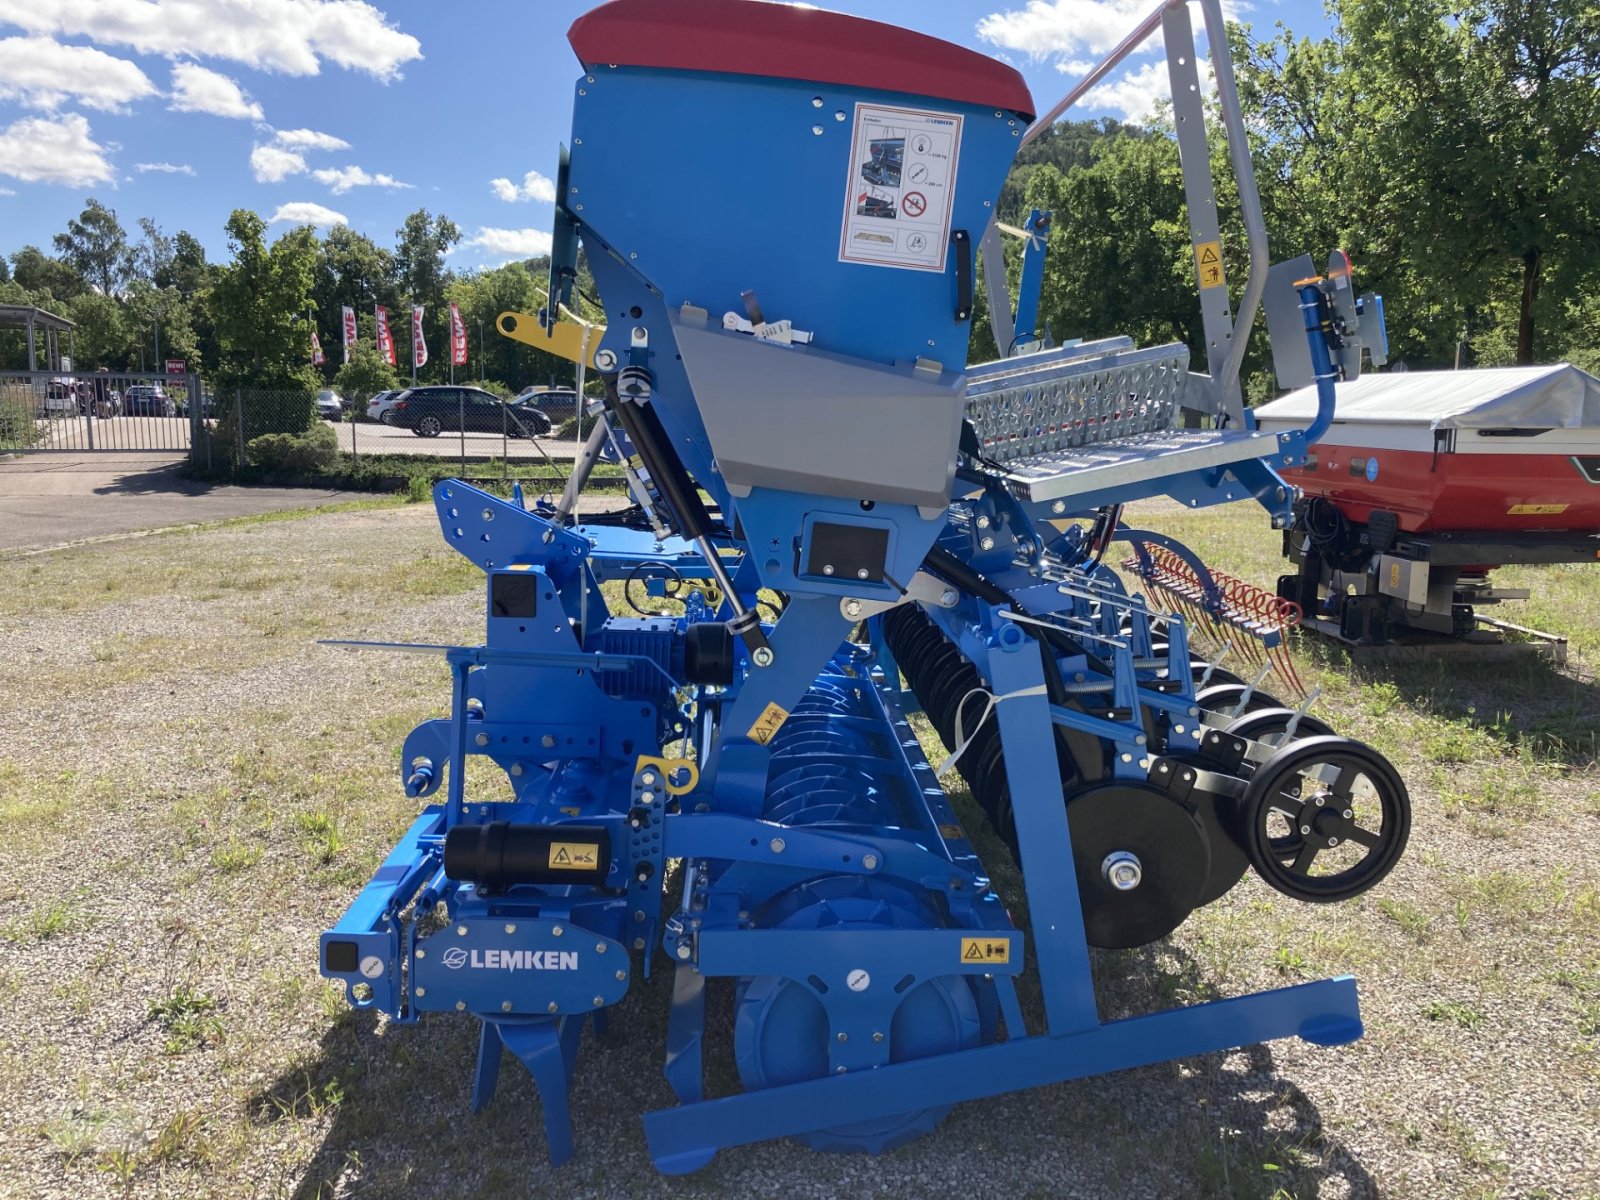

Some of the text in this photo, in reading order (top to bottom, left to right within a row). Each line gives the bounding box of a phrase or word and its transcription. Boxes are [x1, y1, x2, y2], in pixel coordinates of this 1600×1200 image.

[414, 310, 424, 364] REWE
[452, 307, 465, 362] REWE
[470, 949, 579, 973] LEMKEN
